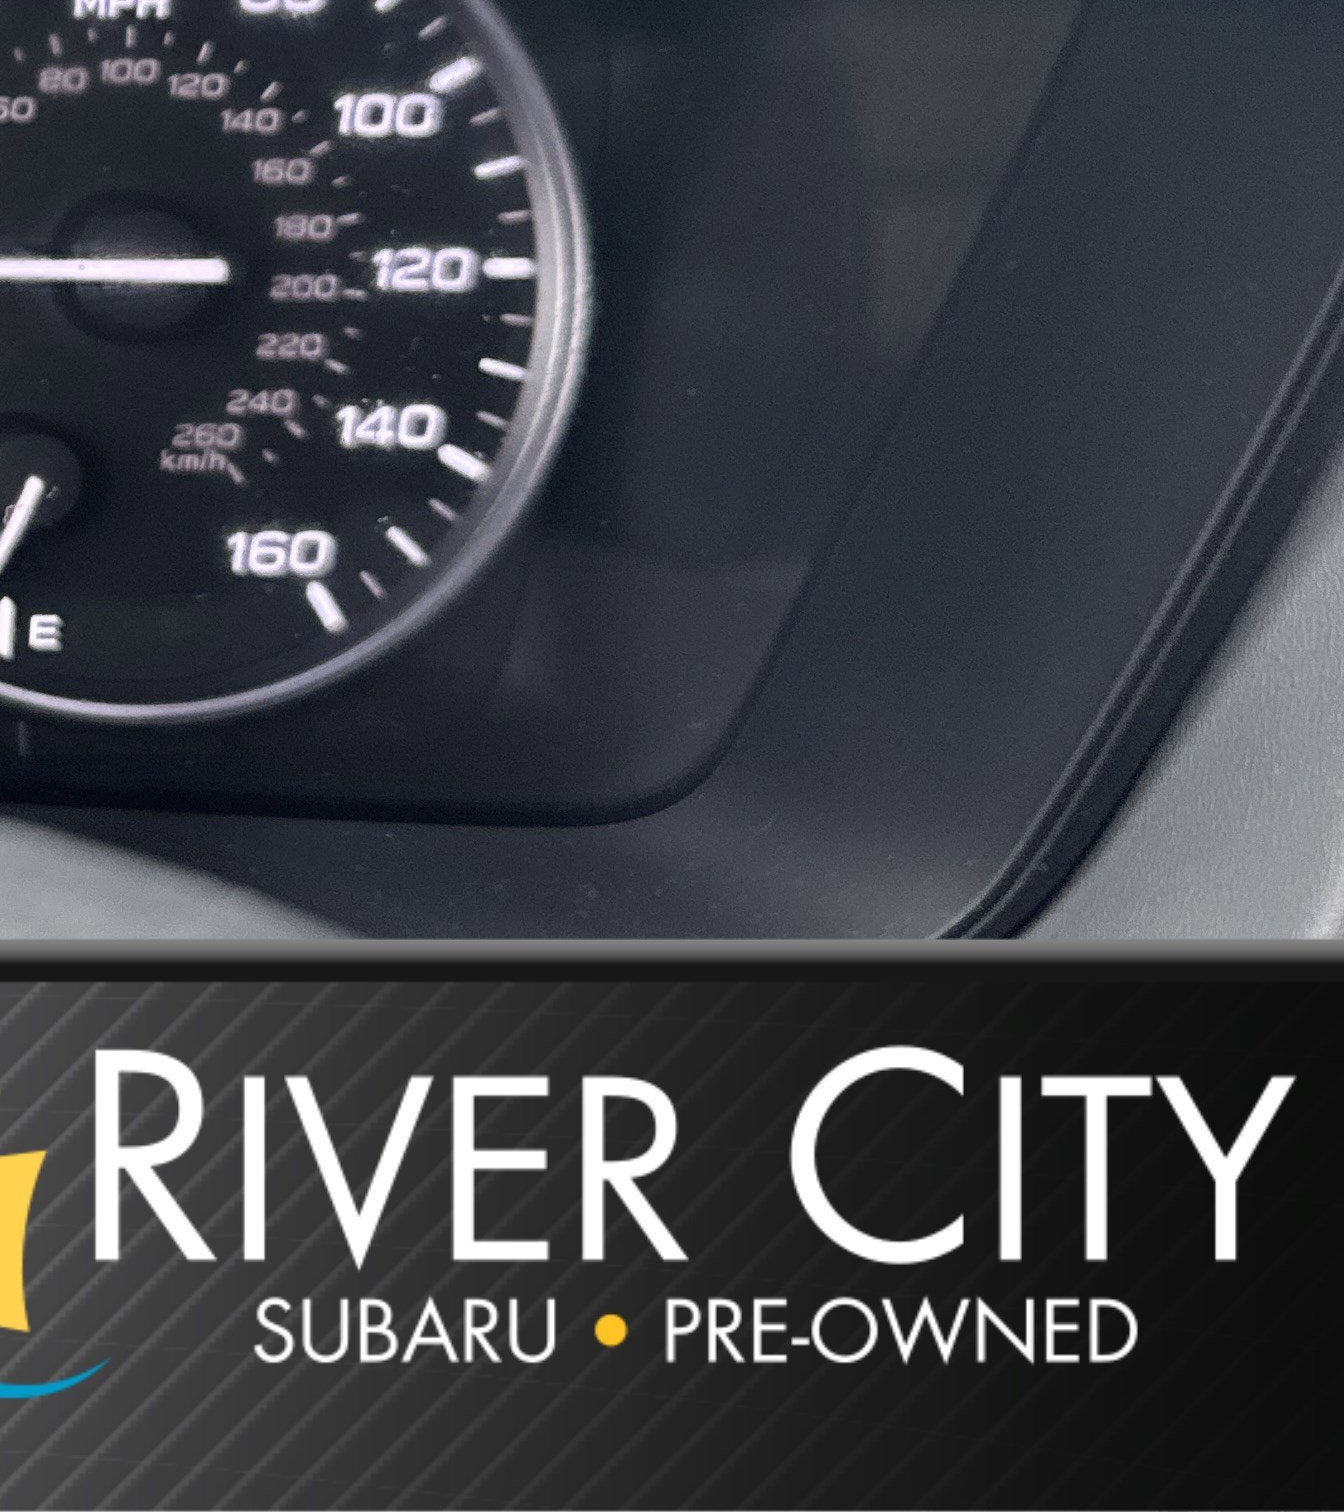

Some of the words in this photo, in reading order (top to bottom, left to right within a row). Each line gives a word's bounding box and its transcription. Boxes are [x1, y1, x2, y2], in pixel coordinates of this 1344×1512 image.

[38, 67, 88, 93] 80
[101, 58, 160, 84] 100
[169, 74, 229, 100] 120
[221, 108, 283, 133] 140
[334, 92, 444, 138] 100
[253, 158, 312, 184] 160
[274, 214, 337, 240] 180
[372, 247, 478, 293] 120
[269, 275, 340, 301] 200
[256, 333, 326, 360] 220
[227, 389, 298, 415] 240
[173, 423, 242, 449] 260
[337, 404, 446, 449] 140
[160, 450, 227, 473] km/h
[228, 531, 337, 577] 160
[29, 614, 63, 651] E
